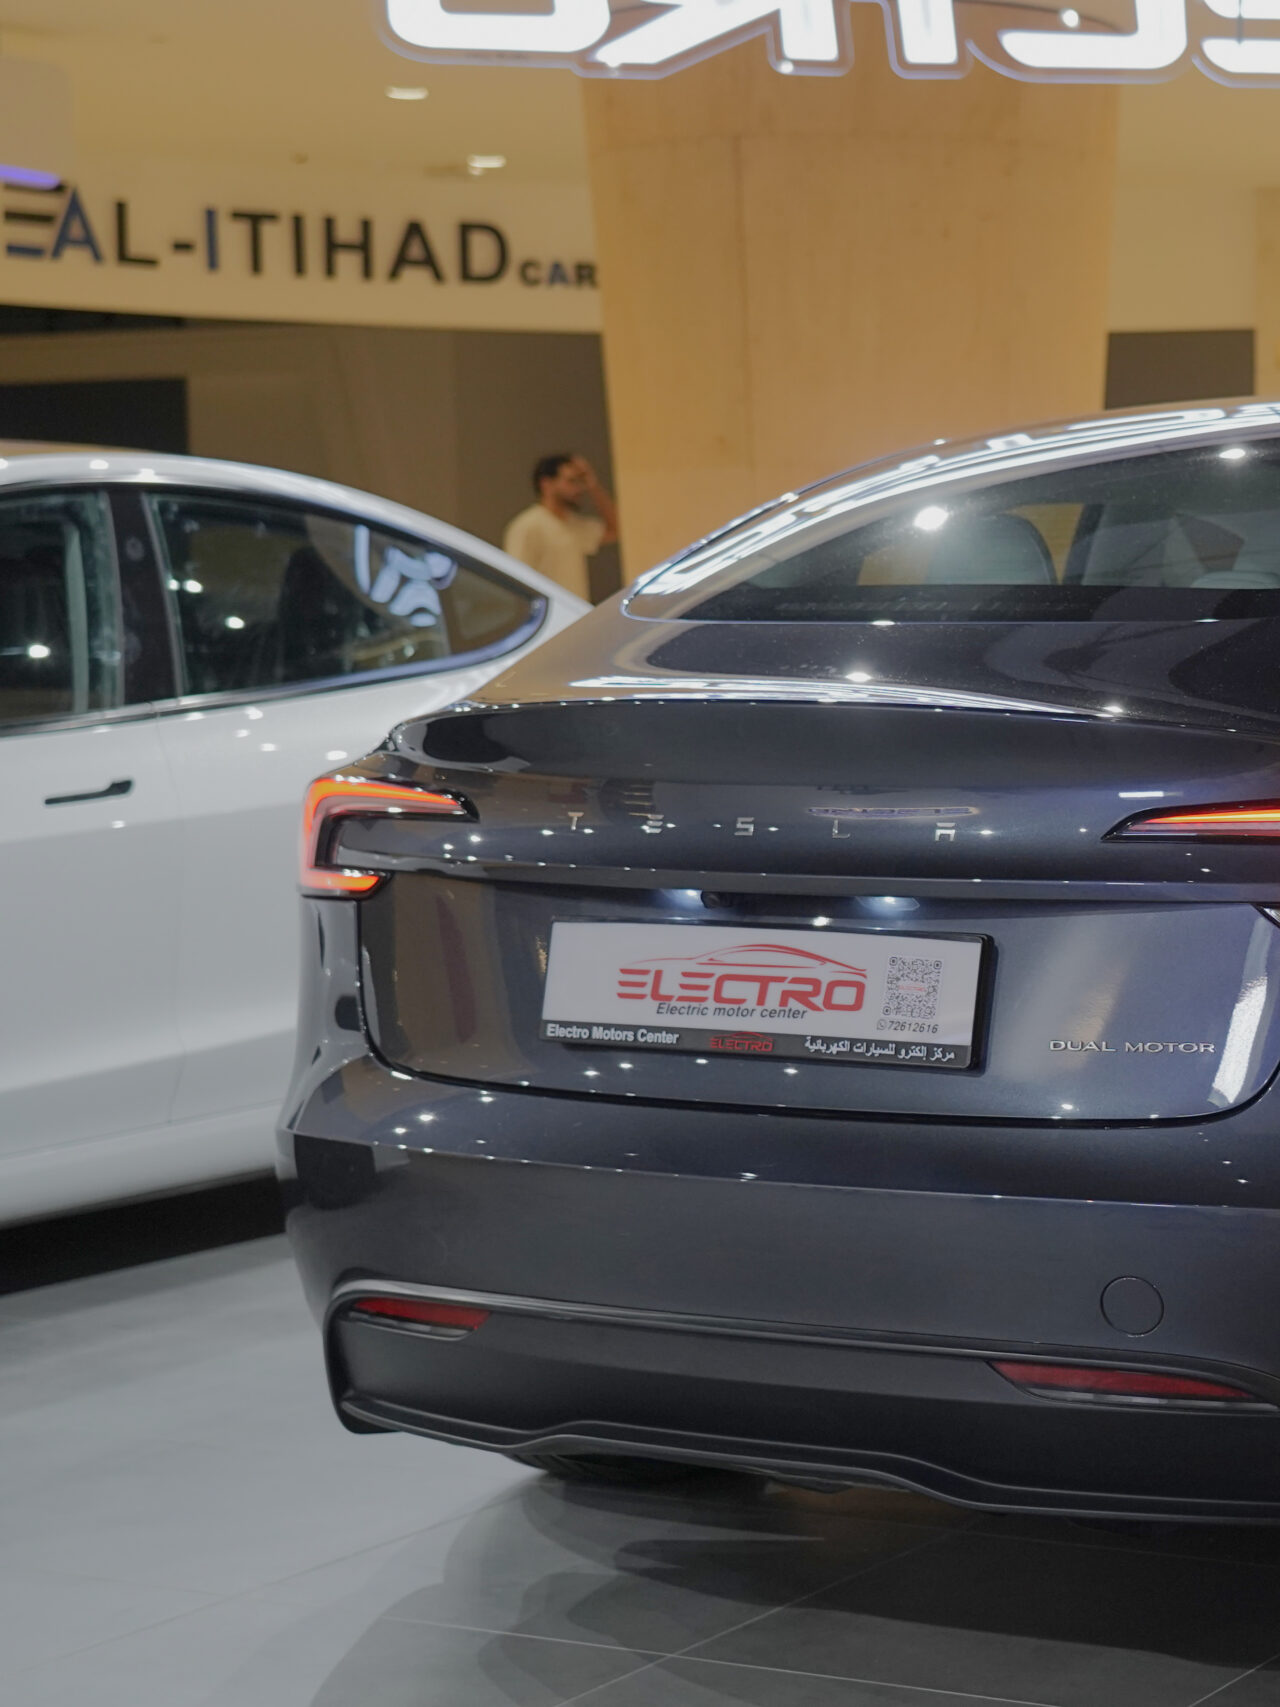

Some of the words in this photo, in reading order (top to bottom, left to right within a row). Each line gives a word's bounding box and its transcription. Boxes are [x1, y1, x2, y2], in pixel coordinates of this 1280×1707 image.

[568, 812, 956, 842] TESLA
[617, 968, 866, 1012] ELECTRO
[656, 1002, 709, 1017] Electric
[713, 1005, 756, 1018] motor
[760, 1007, 807, 1020] center
[546, 1023, 589, 1039] Electro
[592, 1026, 634, 1042] Motors
[637, 1028, 679, 1044] Center
[888, 1020, 939, 1034] 72612616
[710, 1038, 773, 1052] ELECTRO
[853, 1042, 896, 1057] للسيارات
[1049, 1040, 1117, 1053] DUAL
[1124, 1042, 1216, 1054] MOTOR
[929, 1046, 955, 1062] مركز
